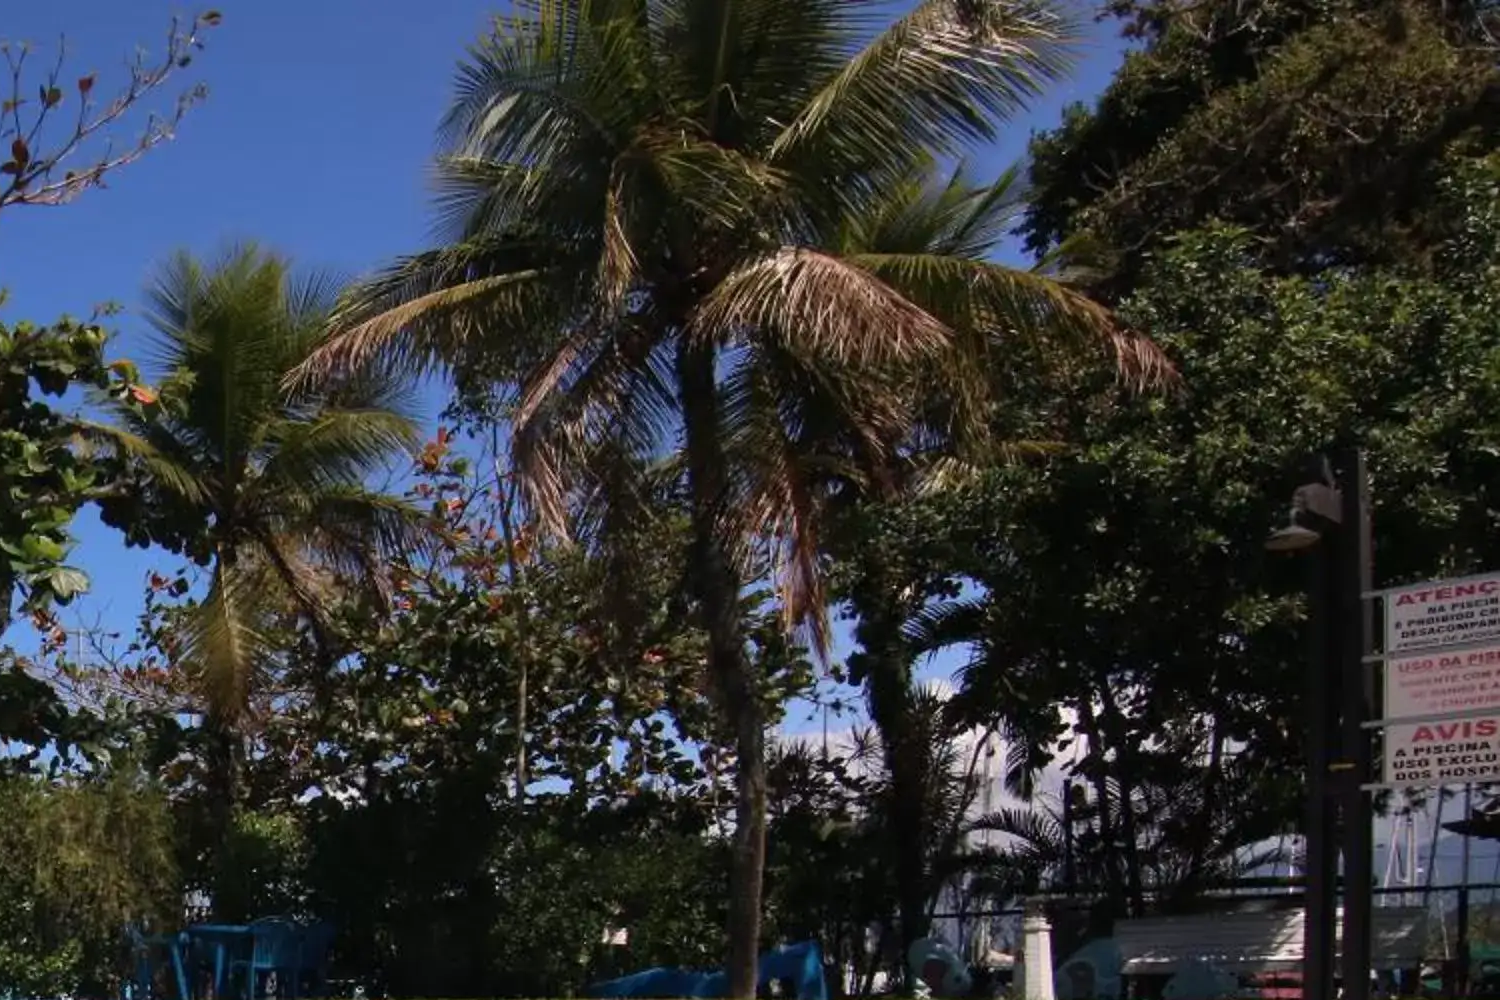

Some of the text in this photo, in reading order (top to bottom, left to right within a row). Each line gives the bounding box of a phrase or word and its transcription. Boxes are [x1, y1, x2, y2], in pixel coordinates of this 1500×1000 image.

[1398, 660, 1433, 672] USO
[1439, 656, 1461, 667] DA
[1412, 720, 1497, 742] AVIS
[1395, 748, 1406, 757] A
[1413, 741, 1491, 756] PISCINA
[1393, 753, 1497, 769] USO EXCLU
[1395, 769, 1431, 780] DOS
